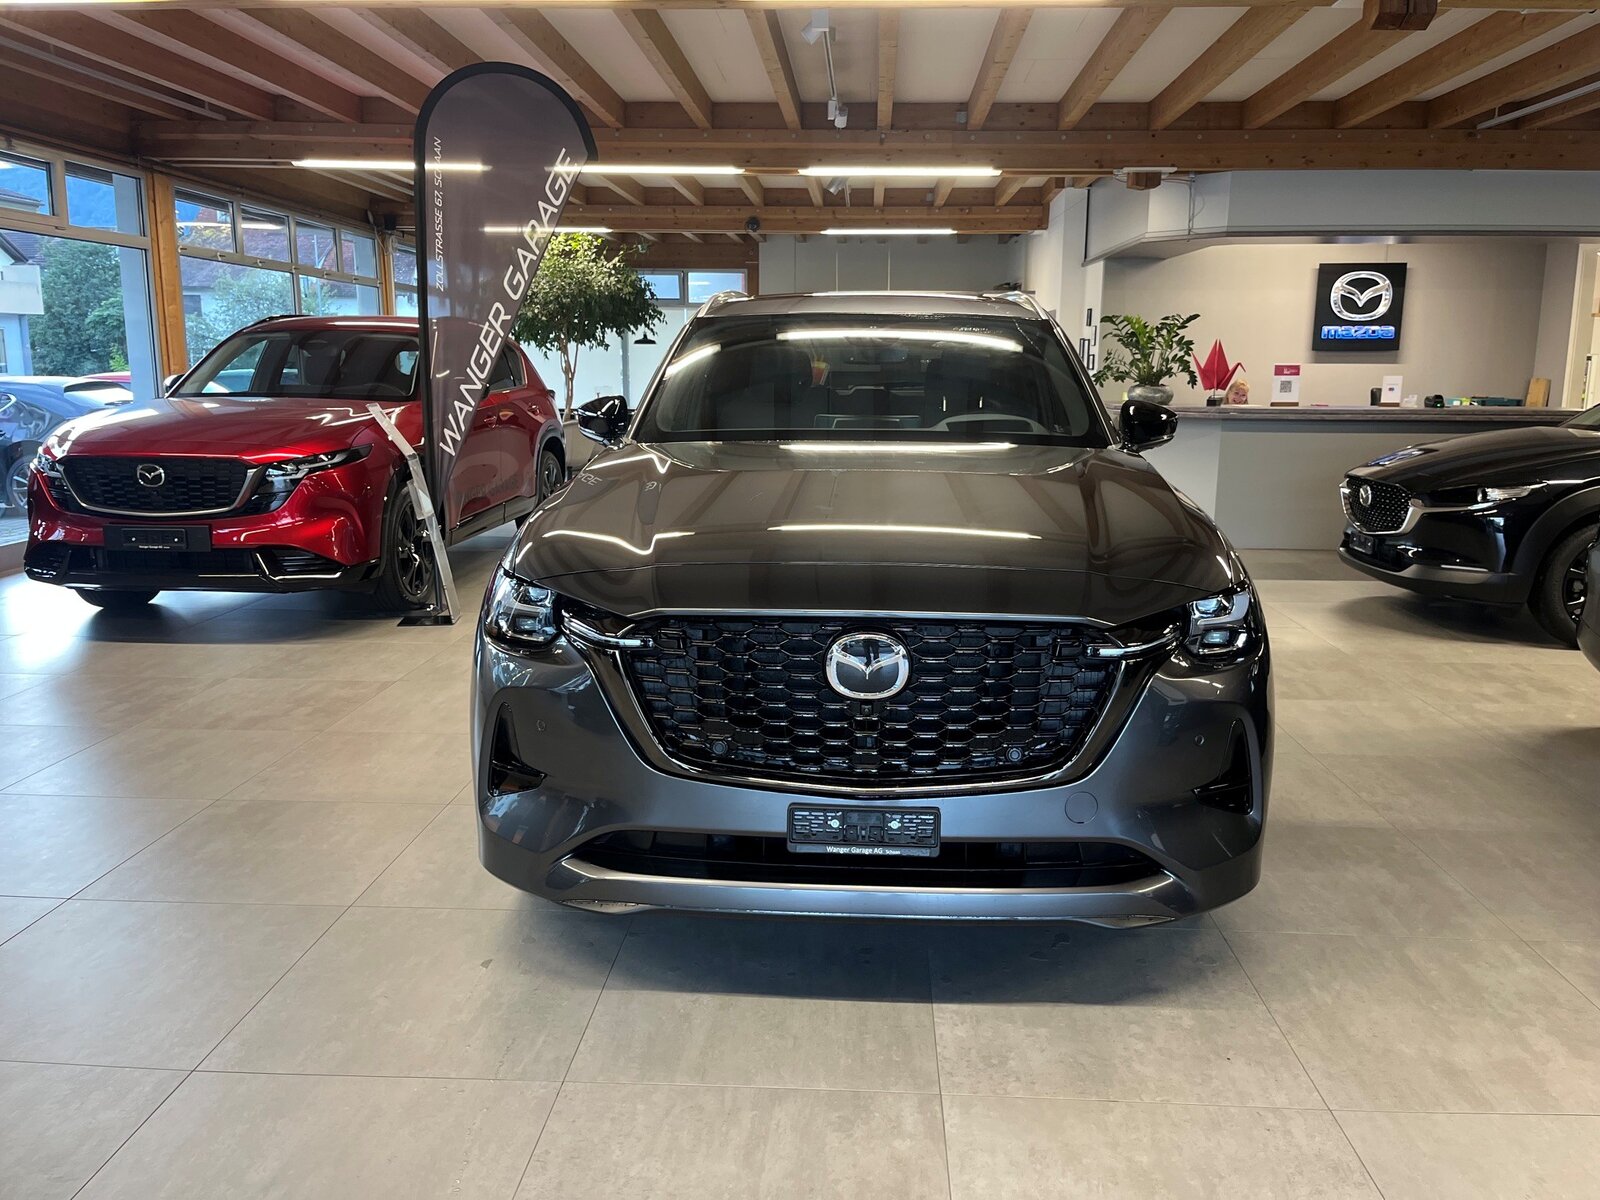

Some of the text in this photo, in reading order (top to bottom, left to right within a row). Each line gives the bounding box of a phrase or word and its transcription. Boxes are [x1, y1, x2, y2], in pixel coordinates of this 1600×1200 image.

[434, 190, 443, 209] 67,
[434, 209, 443, 292] ZOLLSTRASSE
[439, 147, 578, 456] WANGER GARAGE
[1321, 325, 1395, 339] mazda
[826, 845, 850, 854] Wanger
[850, 846, 873, 855] Garage
[873, 847, 883, 855] AG
